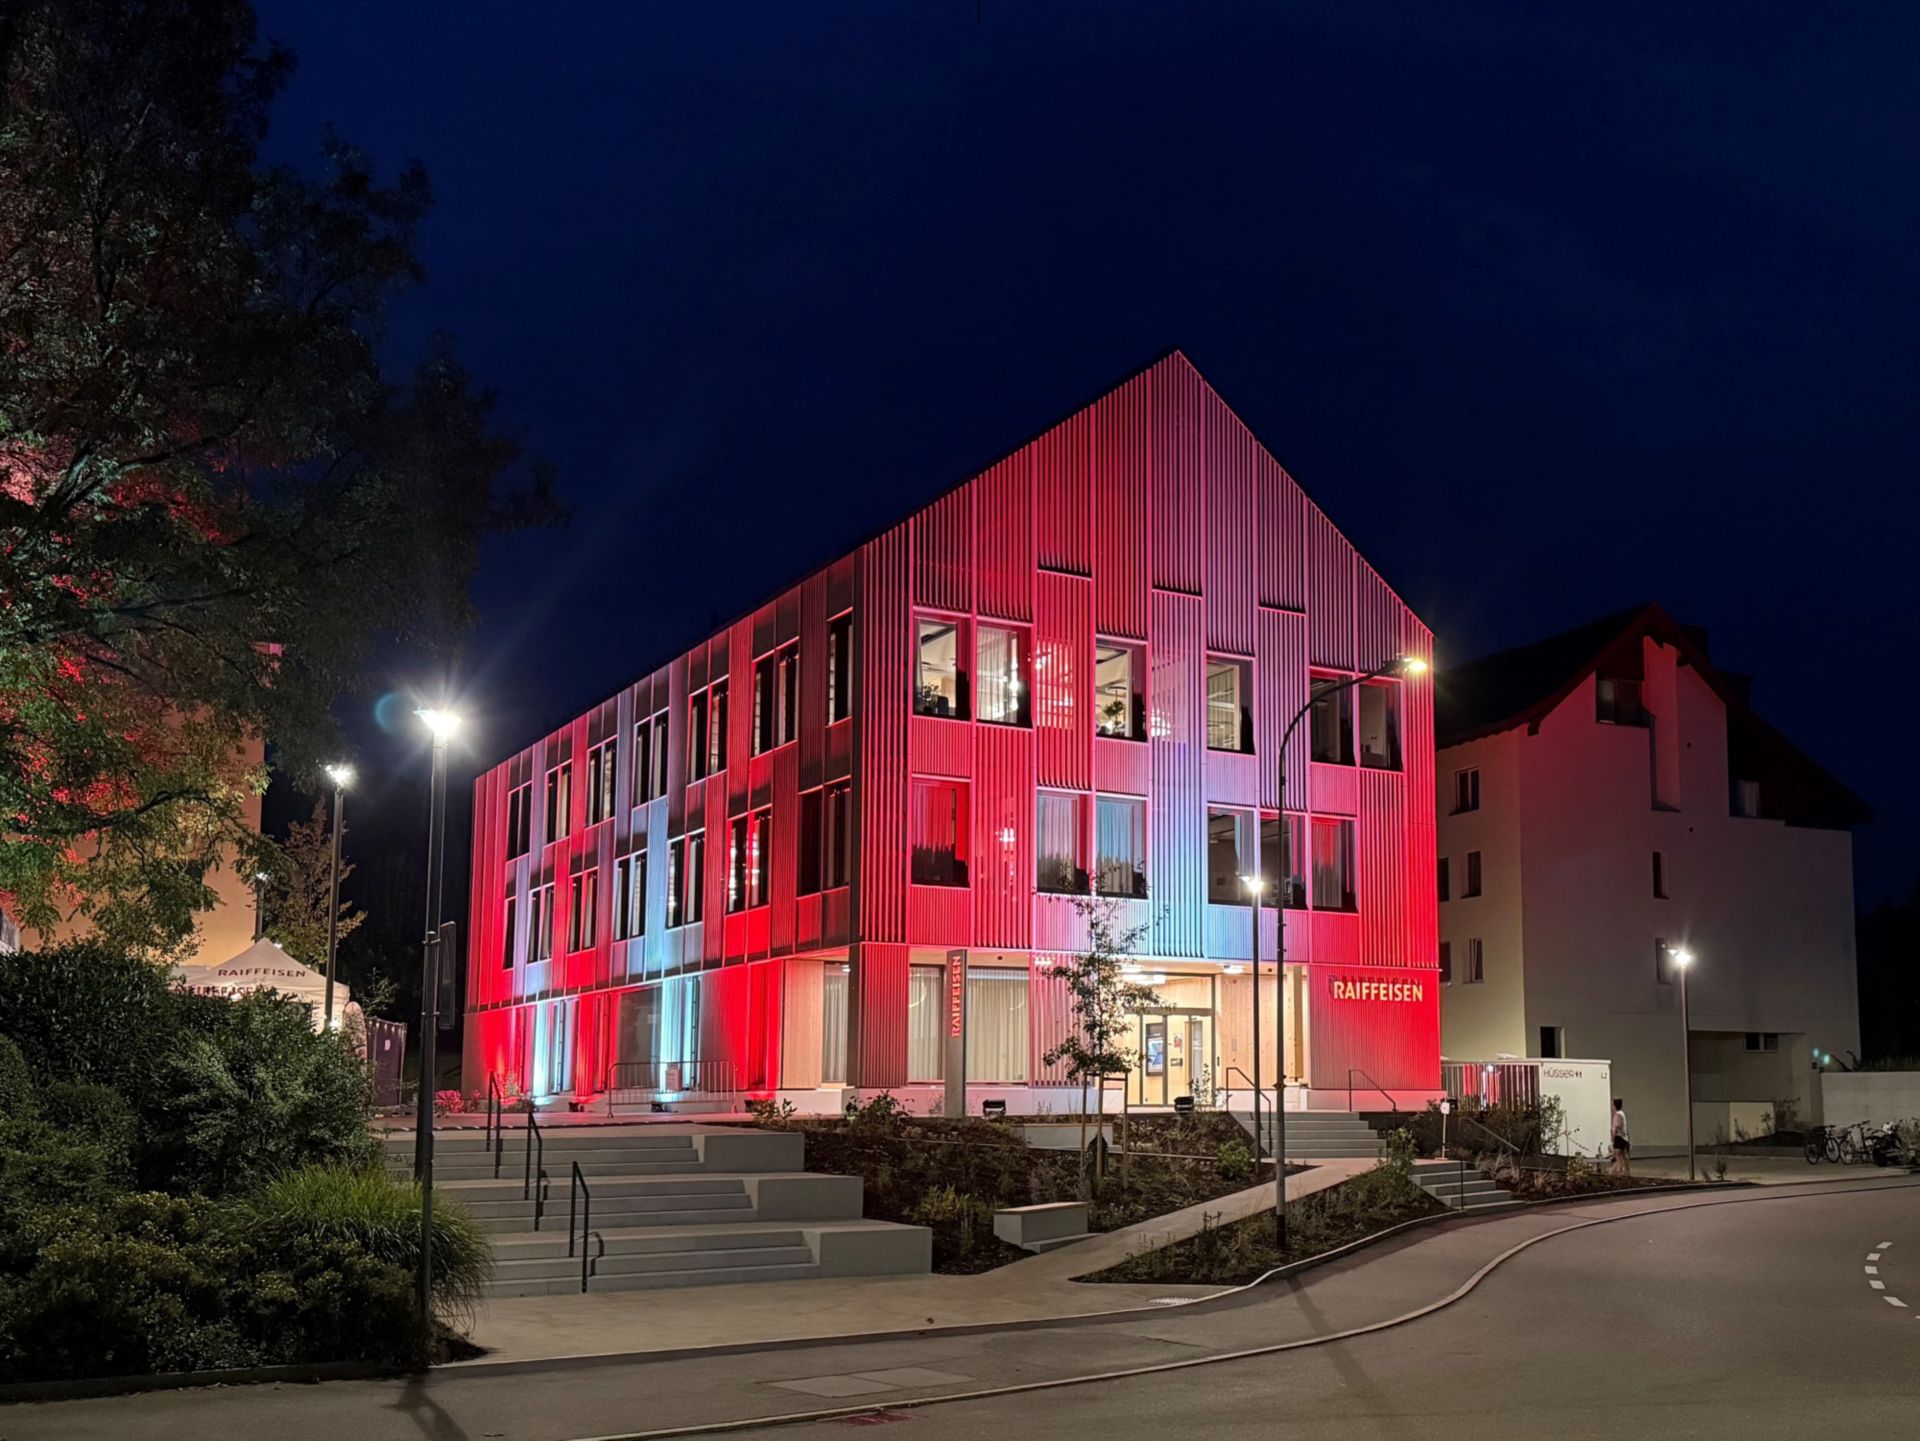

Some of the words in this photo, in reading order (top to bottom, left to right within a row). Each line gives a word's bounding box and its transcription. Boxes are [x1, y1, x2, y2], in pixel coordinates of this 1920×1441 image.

[218, 967, 306, 977] RAIFFEISEN
[951, 955, 961, 1037] RAIFFEISEN
[1333, 981, 1423, 1002] RAIFFEISEN
